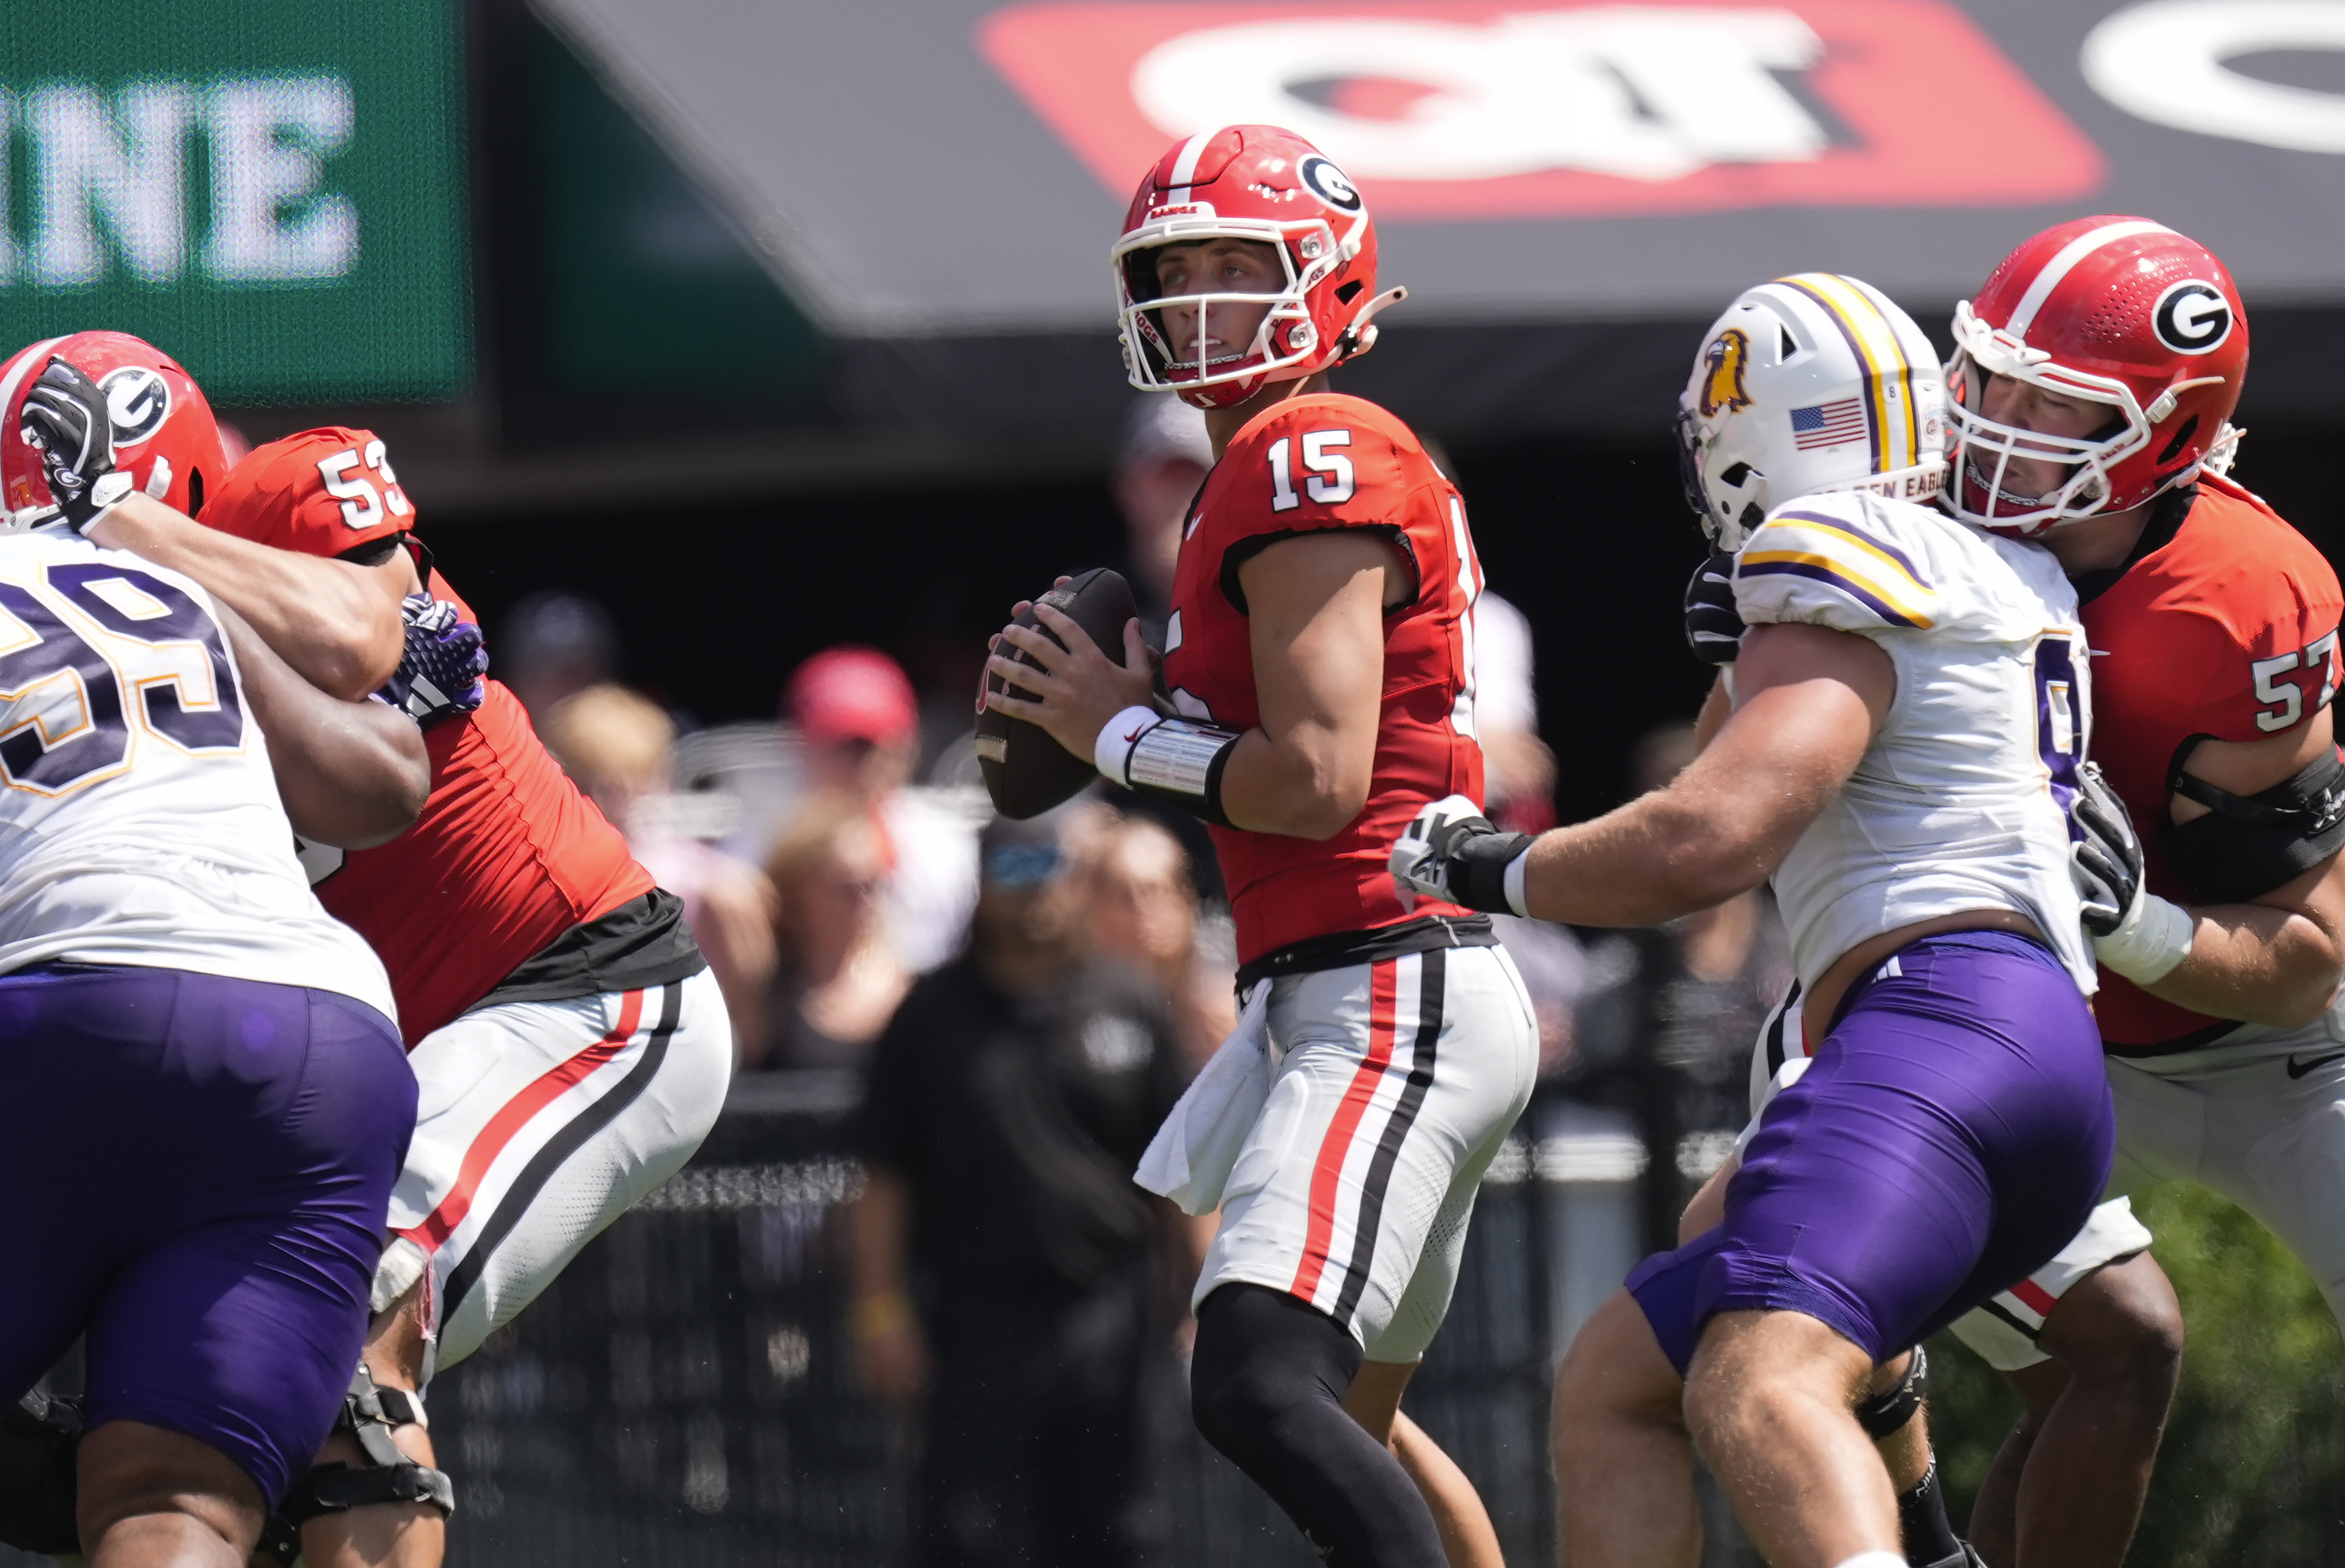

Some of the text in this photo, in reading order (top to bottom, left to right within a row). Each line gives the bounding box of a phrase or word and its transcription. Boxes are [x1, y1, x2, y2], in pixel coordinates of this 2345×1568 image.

[2155, 284, 2230, 350] G
[315, 439, 409, 531] 53
[1266, 428, 1356, 514] 15
[2251, 626, 2339, 733] 57
